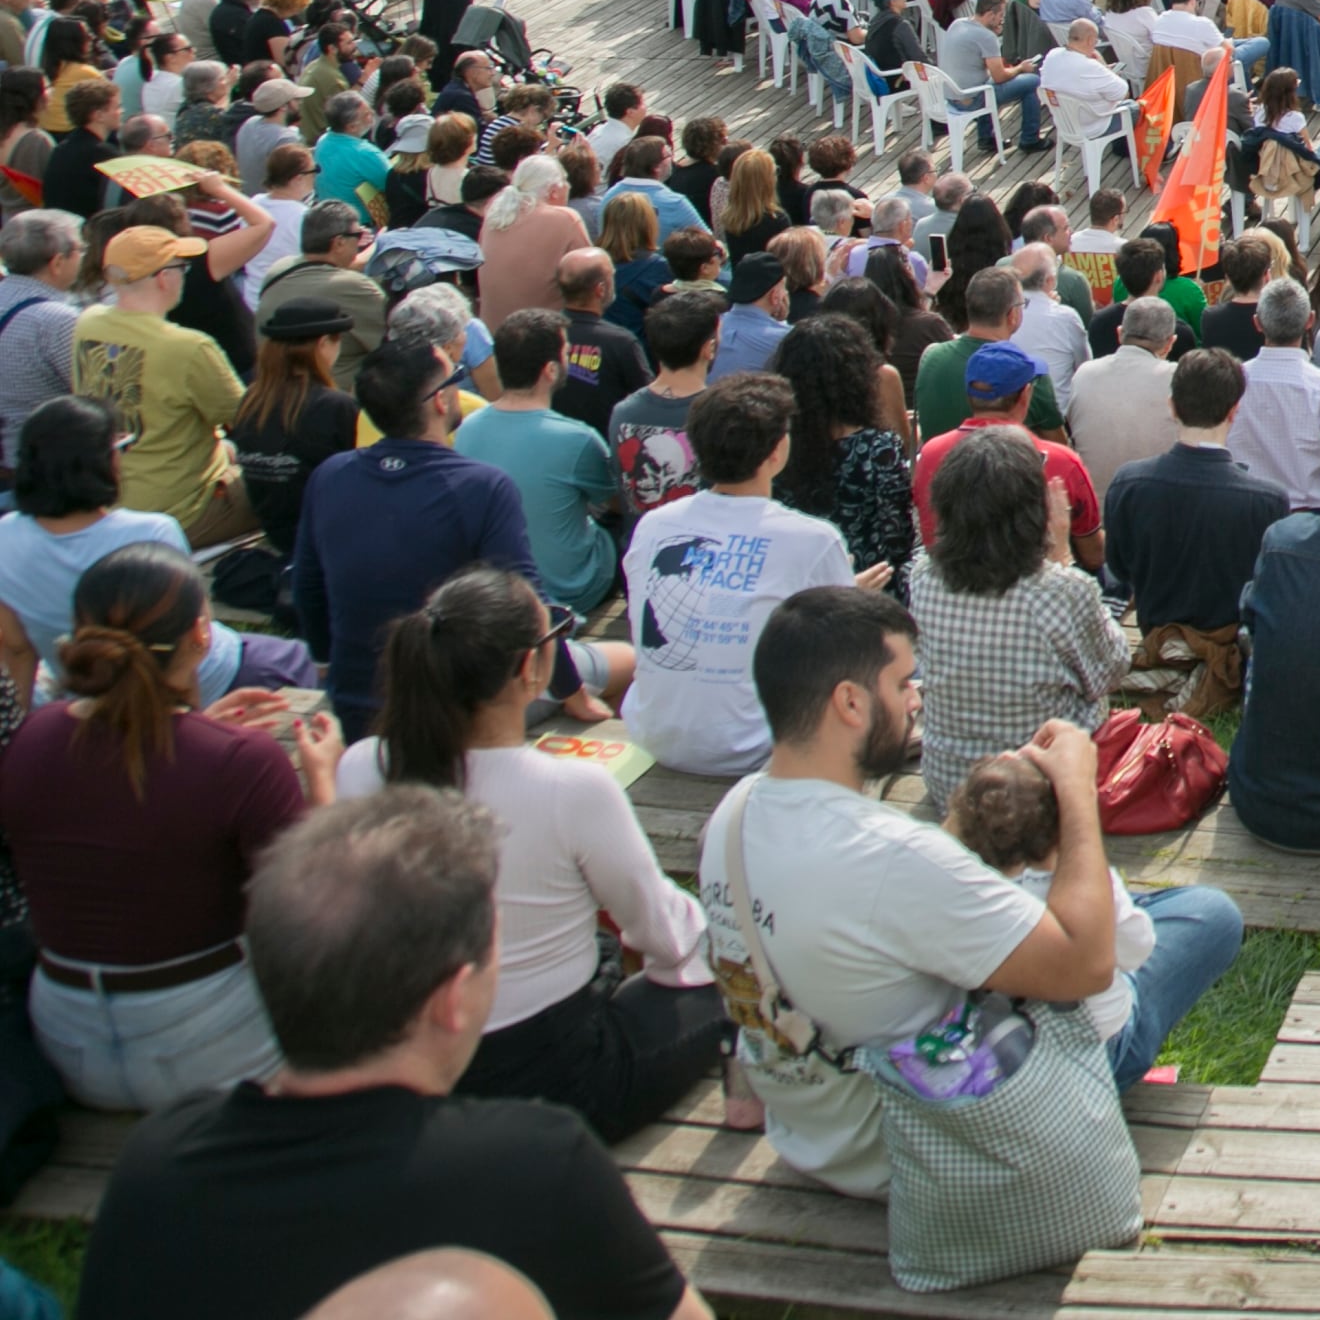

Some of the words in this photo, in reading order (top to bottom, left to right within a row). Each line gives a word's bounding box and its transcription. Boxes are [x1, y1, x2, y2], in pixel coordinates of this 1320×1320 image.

[728, 534, 772, 554] THE
[680, 546, 768, 575] NORTH
[700, 568, 759, 592] FACE
